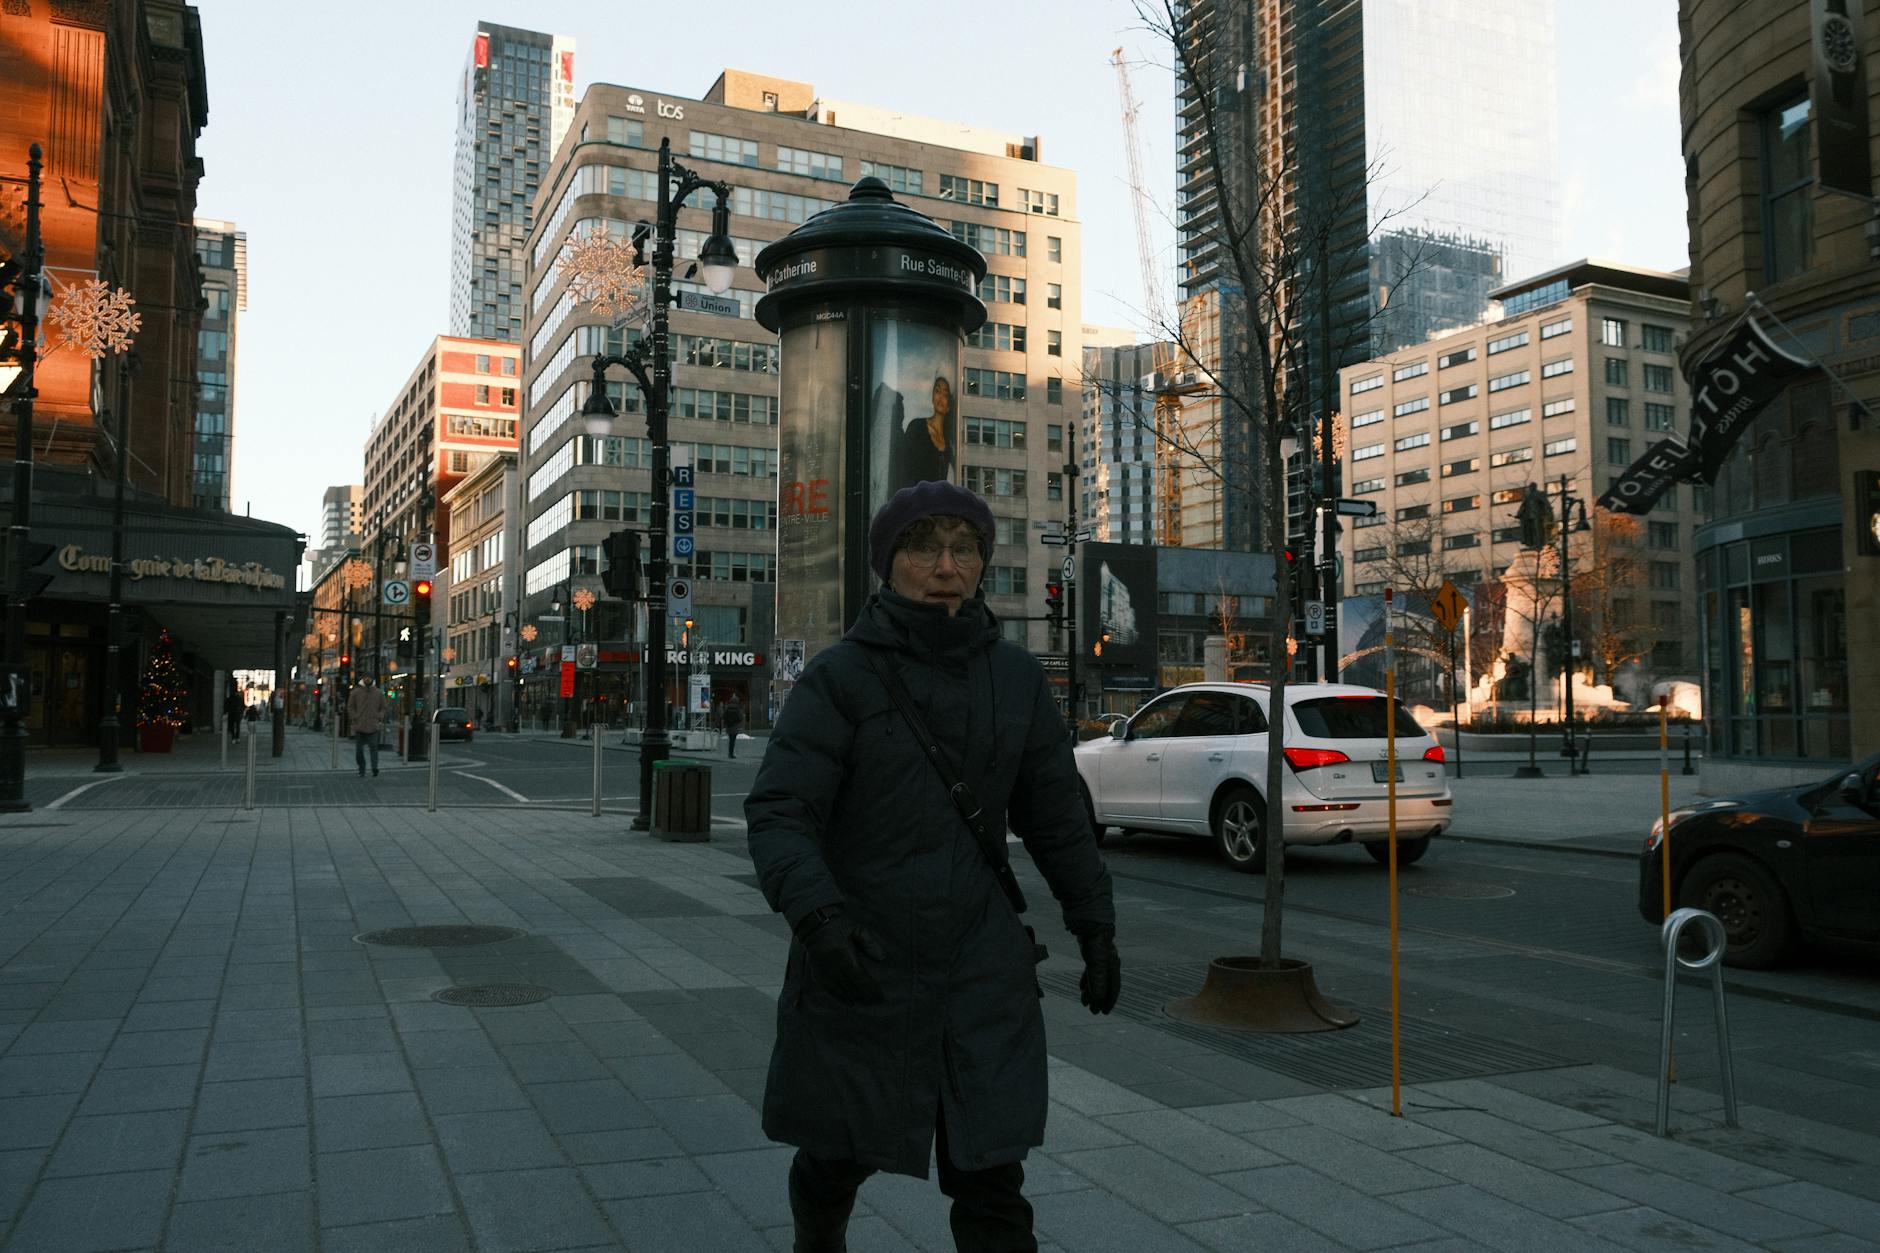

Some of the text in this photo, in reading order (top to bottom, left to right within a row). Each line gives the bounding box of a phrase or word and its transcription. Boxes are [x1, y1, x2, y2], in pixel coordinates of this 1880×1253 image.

[625, 104, 646, 115] TATA
[657, 98, 685, 121] tcs
[900, 254, 925, 272] Rue
[700, 300, 731, 314] Union
[714, 651, 754, 665] KING
